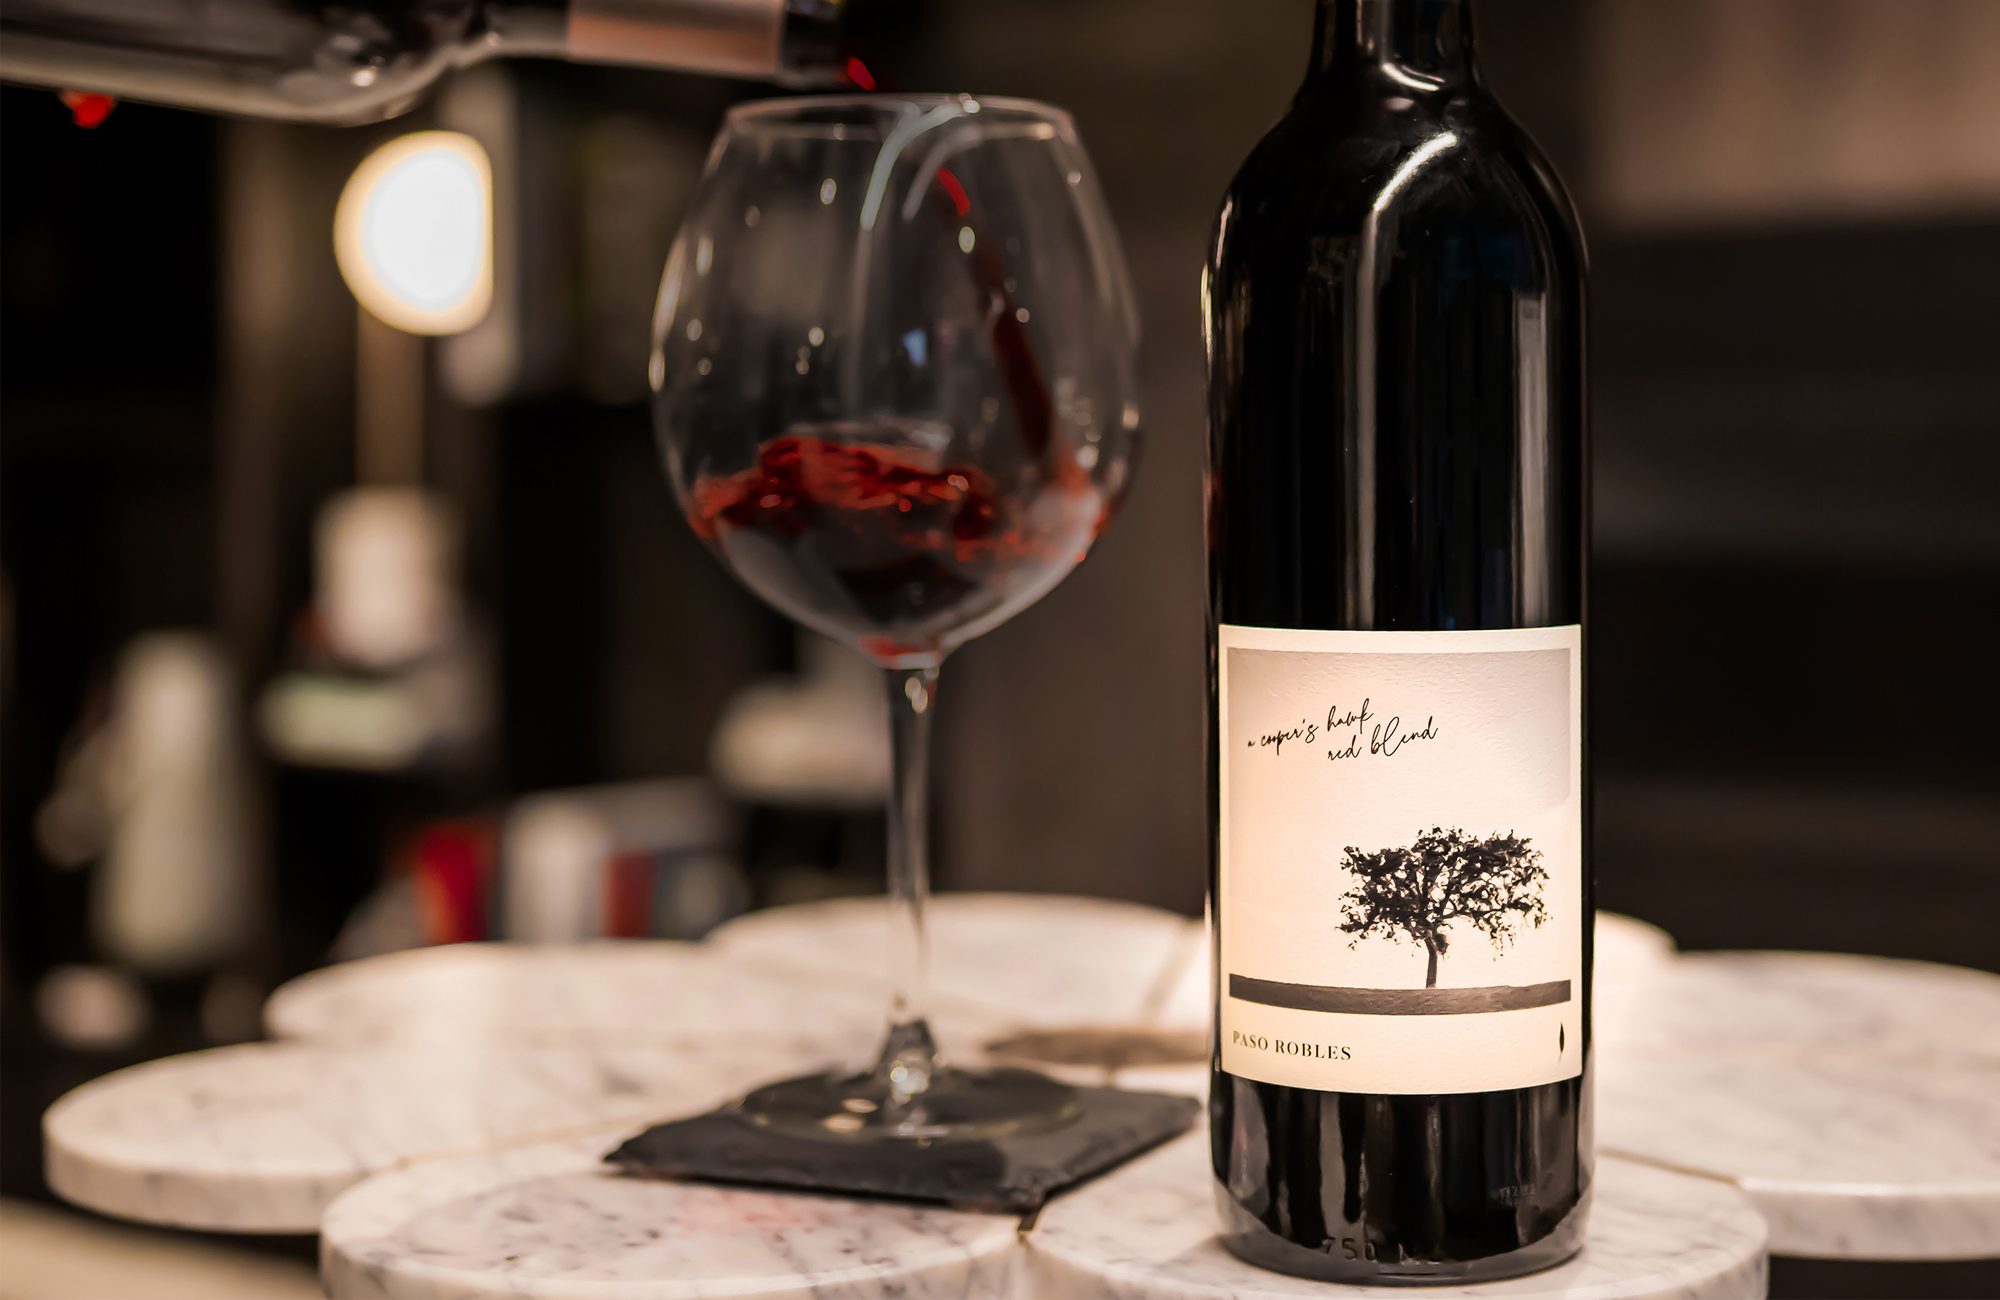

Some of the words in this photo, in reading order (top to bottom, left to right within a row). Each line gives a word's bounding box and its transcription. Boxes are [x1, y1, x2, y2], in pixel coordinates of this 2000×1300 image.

[1260, 718, 1319, 756] cooper's
[1326, 697, 1374, 734] hawk
[1327, 734, 1362, 761] red
[1370, 715, 1439, 757] blend
[1232, 1030, 1268, 1051] PASO
[1275, 1039, 1352, 1061] ROBLES
[1321, 1236, 1378, 1263] 750
